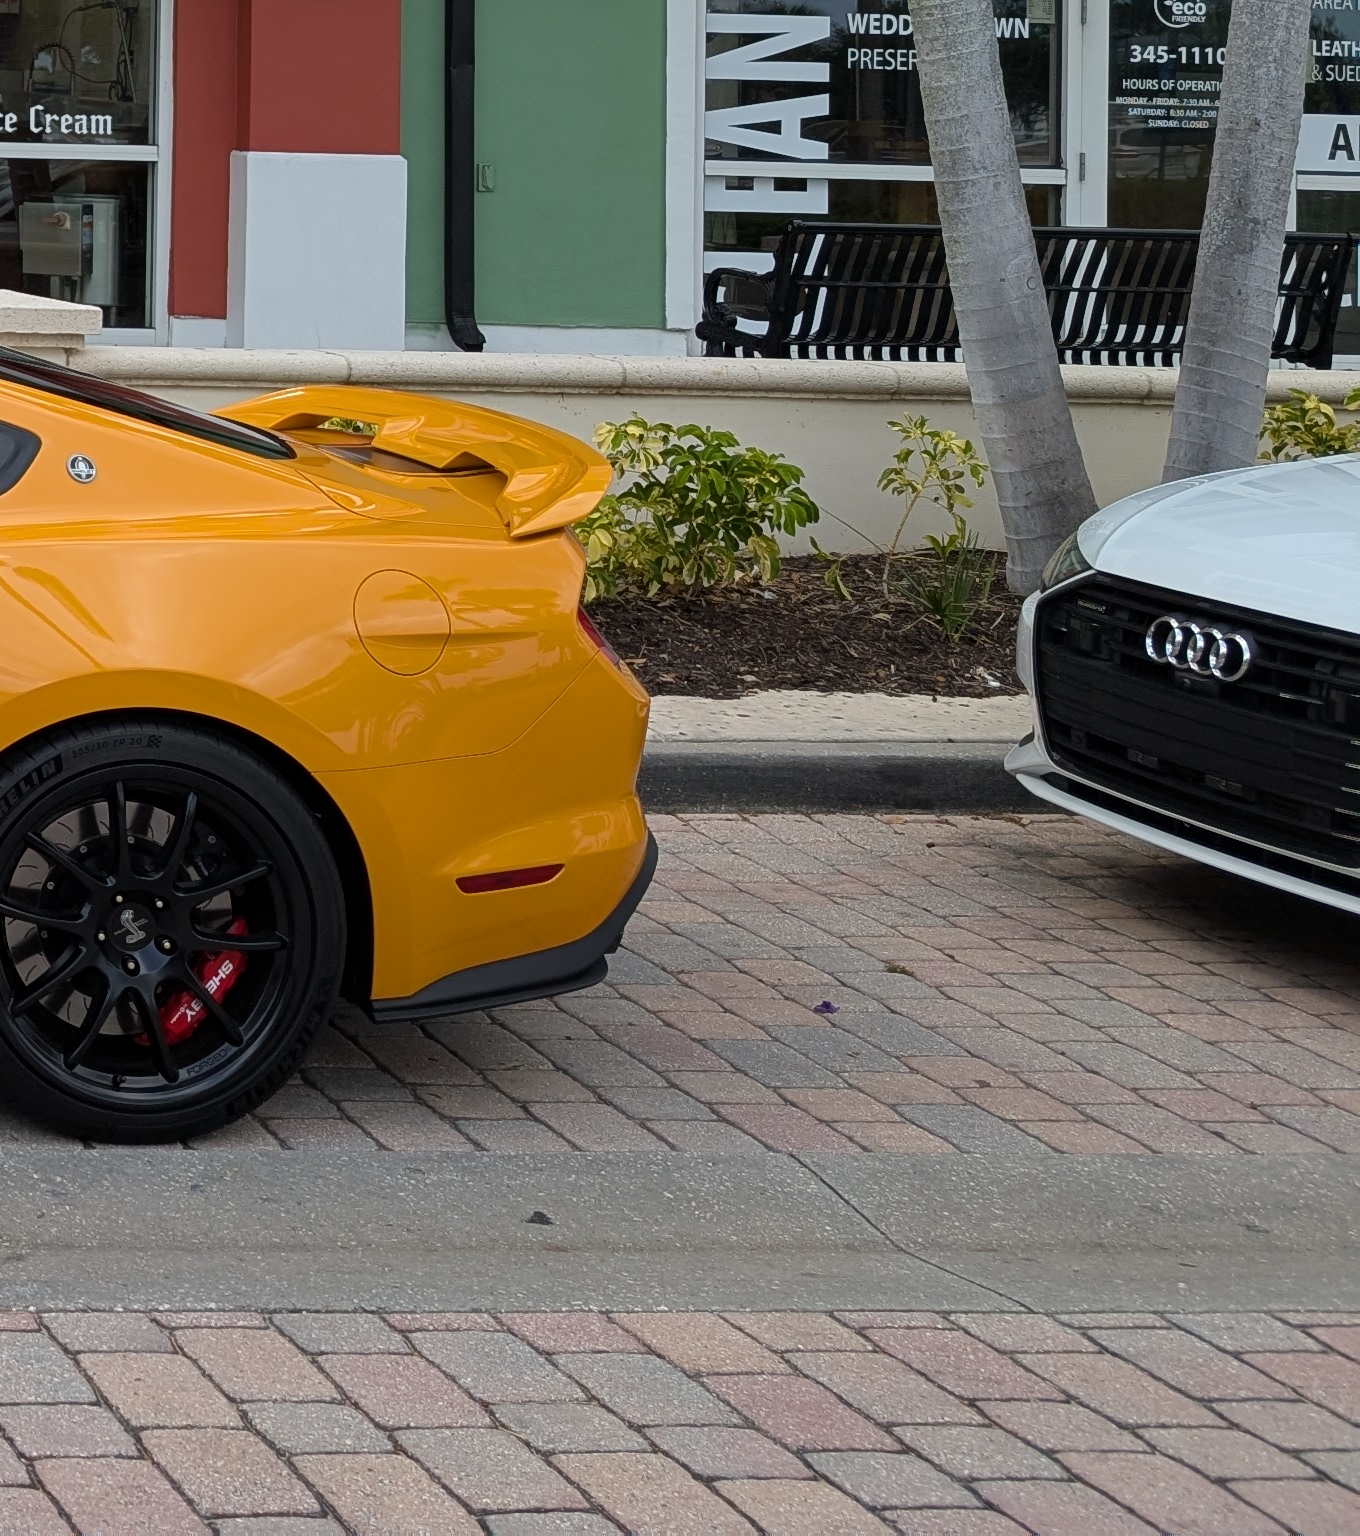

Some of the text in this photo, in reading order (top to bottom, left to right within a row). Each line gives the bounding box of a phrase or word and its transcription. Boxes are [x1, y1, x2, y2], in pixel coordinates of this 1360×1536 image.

[1171, 1, 1207, 15] eco
[847, 13, 913, 35] WEDD
[1171, 15, 1207, 23] FRIENDLY
[847, 48, 917, 70] PRESER
[1129, 44, 1227, 64] 345-1110
[1311, 64, 1324, 82] &
[1122, 78, 1223, 92] HOURS OF OPERATI
[1115, 96, 1148, 104] MONDAY
[1153, 97, 1180, 105] FRIDAY:
[29, 105, 114, 136] Cream
[1128, 107, 1168, 116] SATURDAY:
[1185, 109, 1197, 117] AM
[1148, 119, 1210, 129] SUNDAY: CLOSED
[71, 740, 109, 759] 305/30
[129, 736, 143, 747] 20
[186, 959, 234, 1023] SHEBY
[186, 1048, 228, 1078] FORGED
